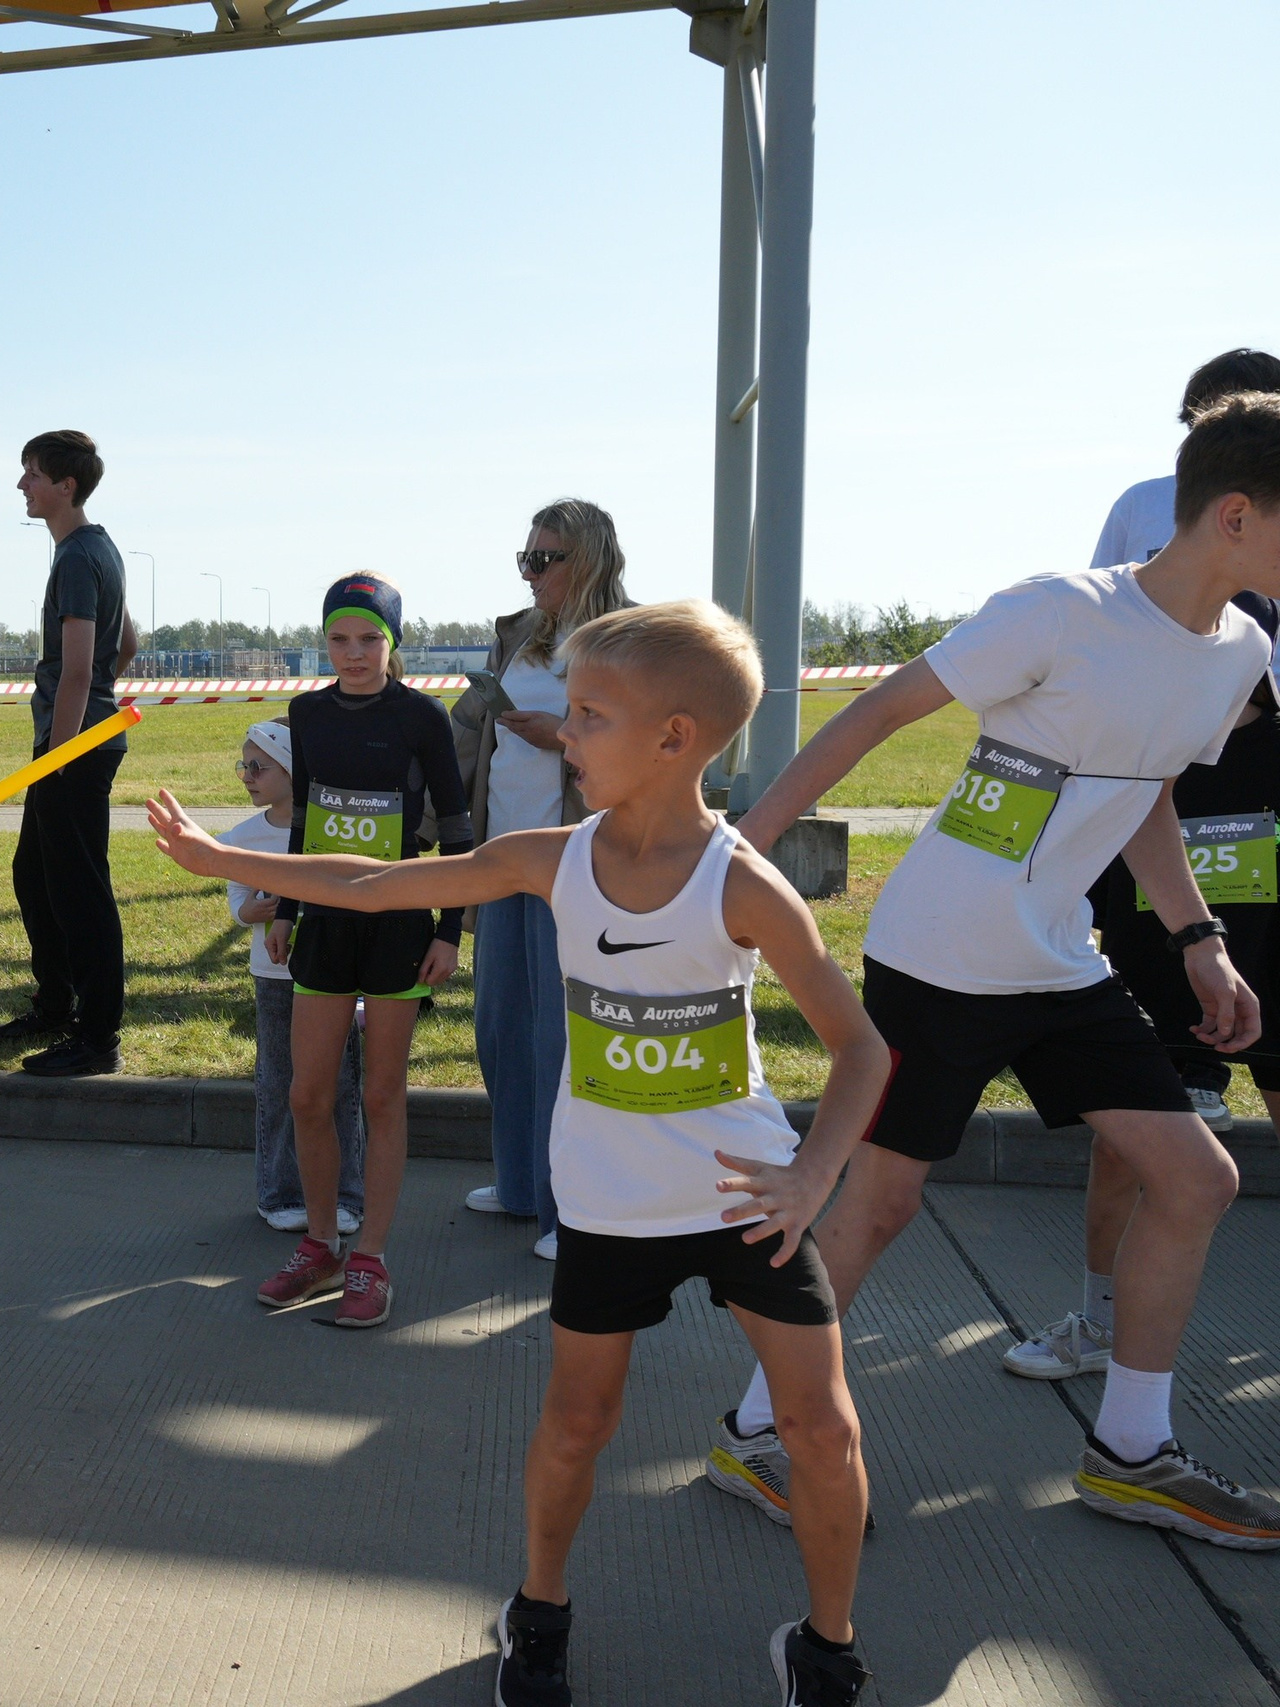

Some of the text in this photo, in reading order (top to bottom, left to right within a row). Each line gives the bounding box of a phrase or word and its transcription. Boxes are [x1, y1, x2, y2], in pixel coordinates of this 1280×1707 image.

[993, 765, 1020, 778] 2025
[952, 770, 1005, 812] 618
[324, 814, 377, 842] 630
[1013, 821, 1019, 830] 1
[384, 840, 390, 848] 2
[1190, 845, 1238, 874] 25
[1252, 869, 1259, 877] 2
[663, 1020, 700, 1028] 2025
[605, 1035, 704, 1074] 604
[719, 1062, 727, 1073] 2
